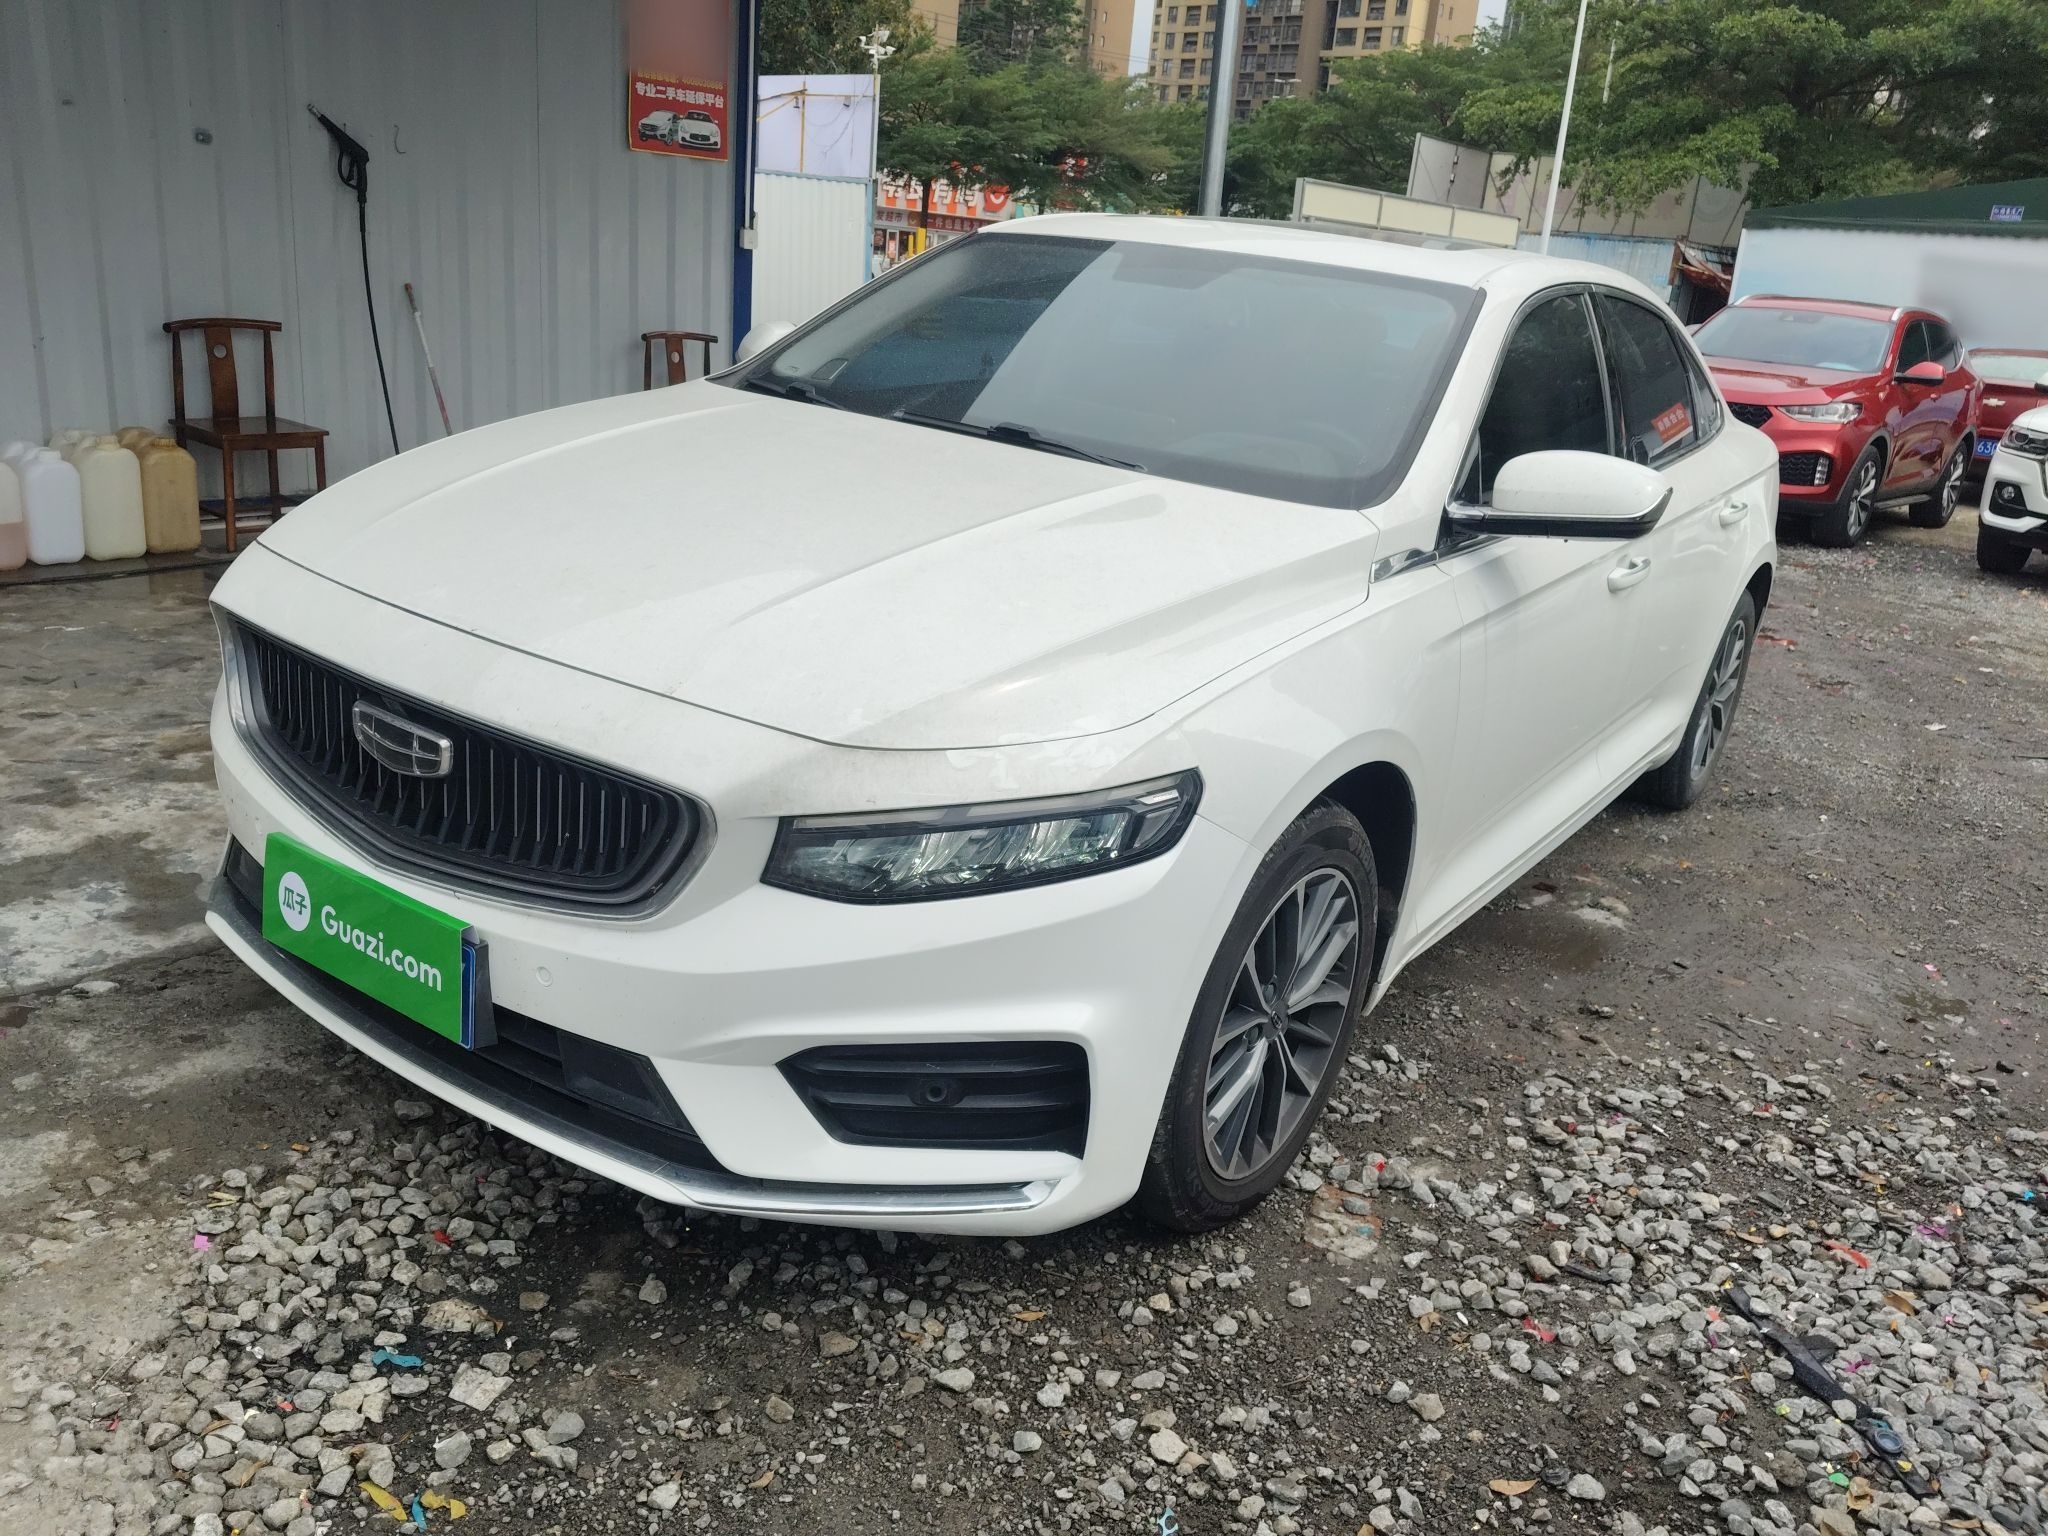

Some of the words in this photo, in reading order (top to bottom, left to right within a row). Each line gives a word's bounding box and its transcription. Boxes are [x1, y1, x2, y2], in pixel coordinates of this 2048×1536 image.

[635, 82, 724, 108] 专业二手车延保平台
[282, 886, 307, 916] 瓜子
[321, 905, 442, 992] Guazi.com
